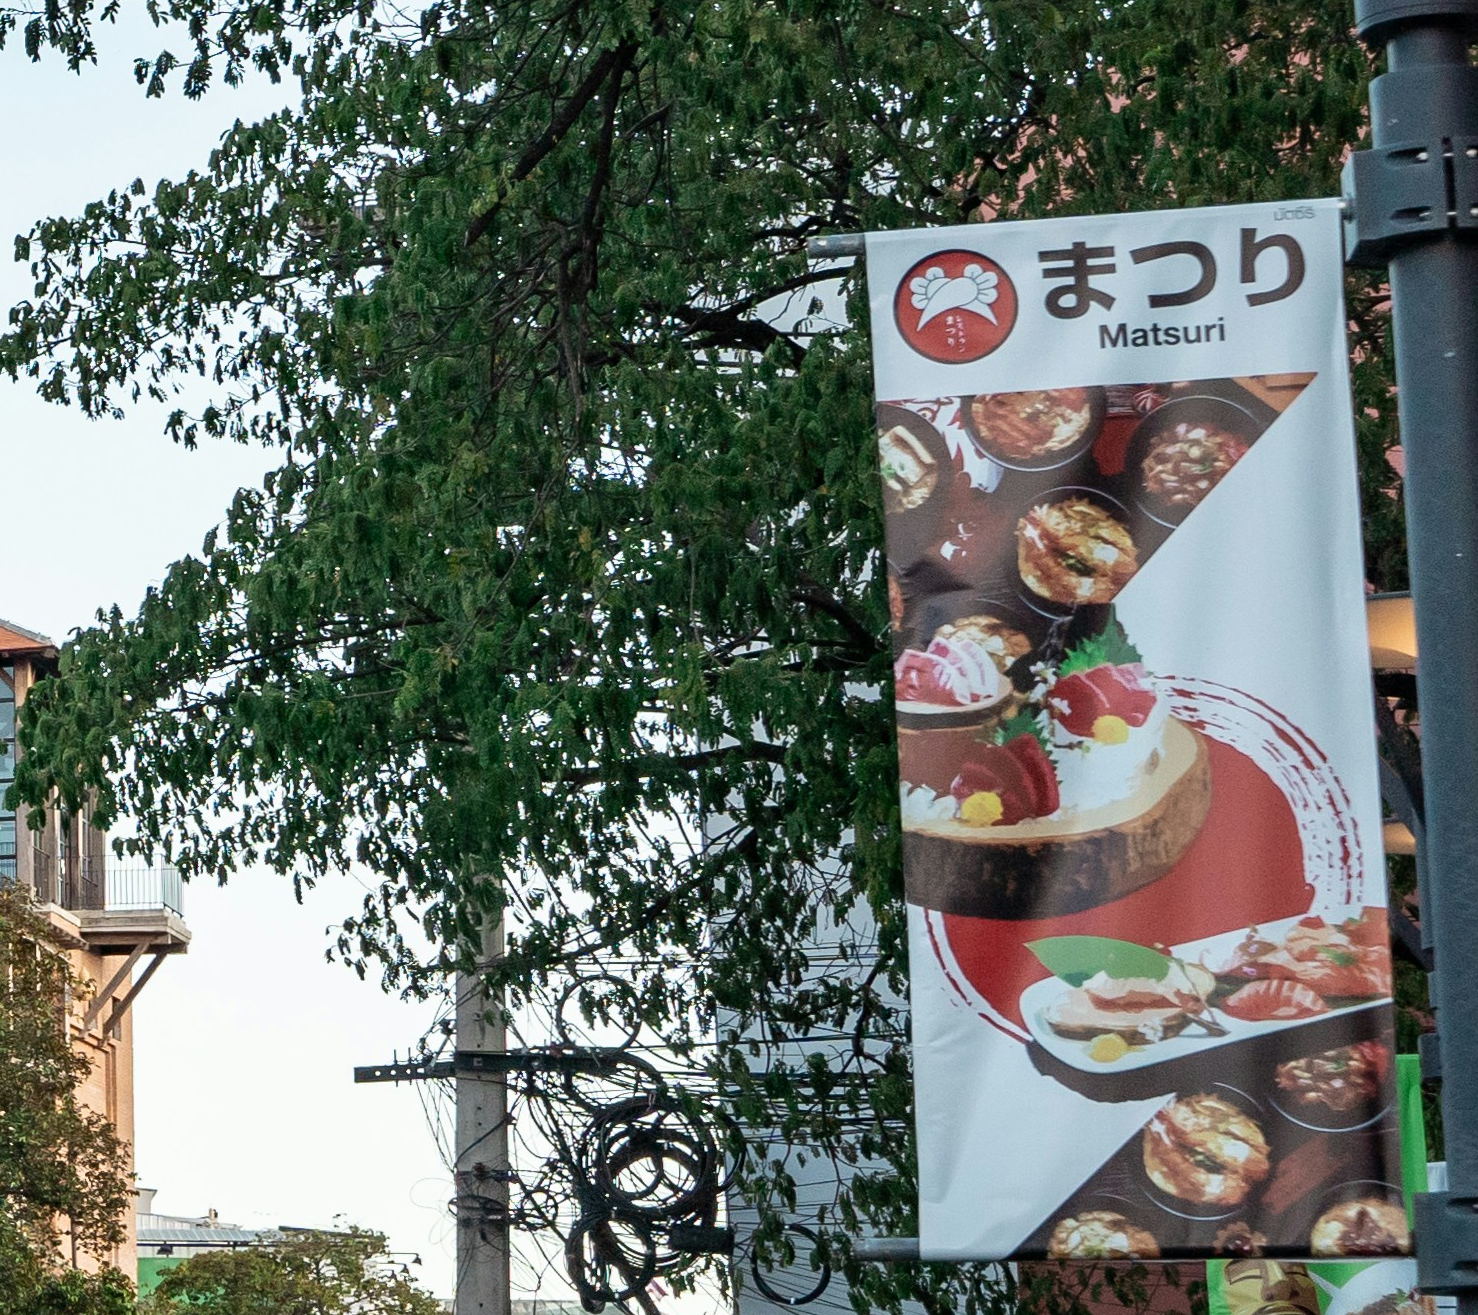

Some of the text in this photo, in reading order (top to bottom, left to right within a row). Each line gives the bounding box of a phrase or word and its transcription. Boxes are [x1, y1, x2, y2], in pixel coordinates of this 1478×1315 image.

[1037, 227, 1306, 320] まつり
[1098, 317, 1226, 350] Matsuri
